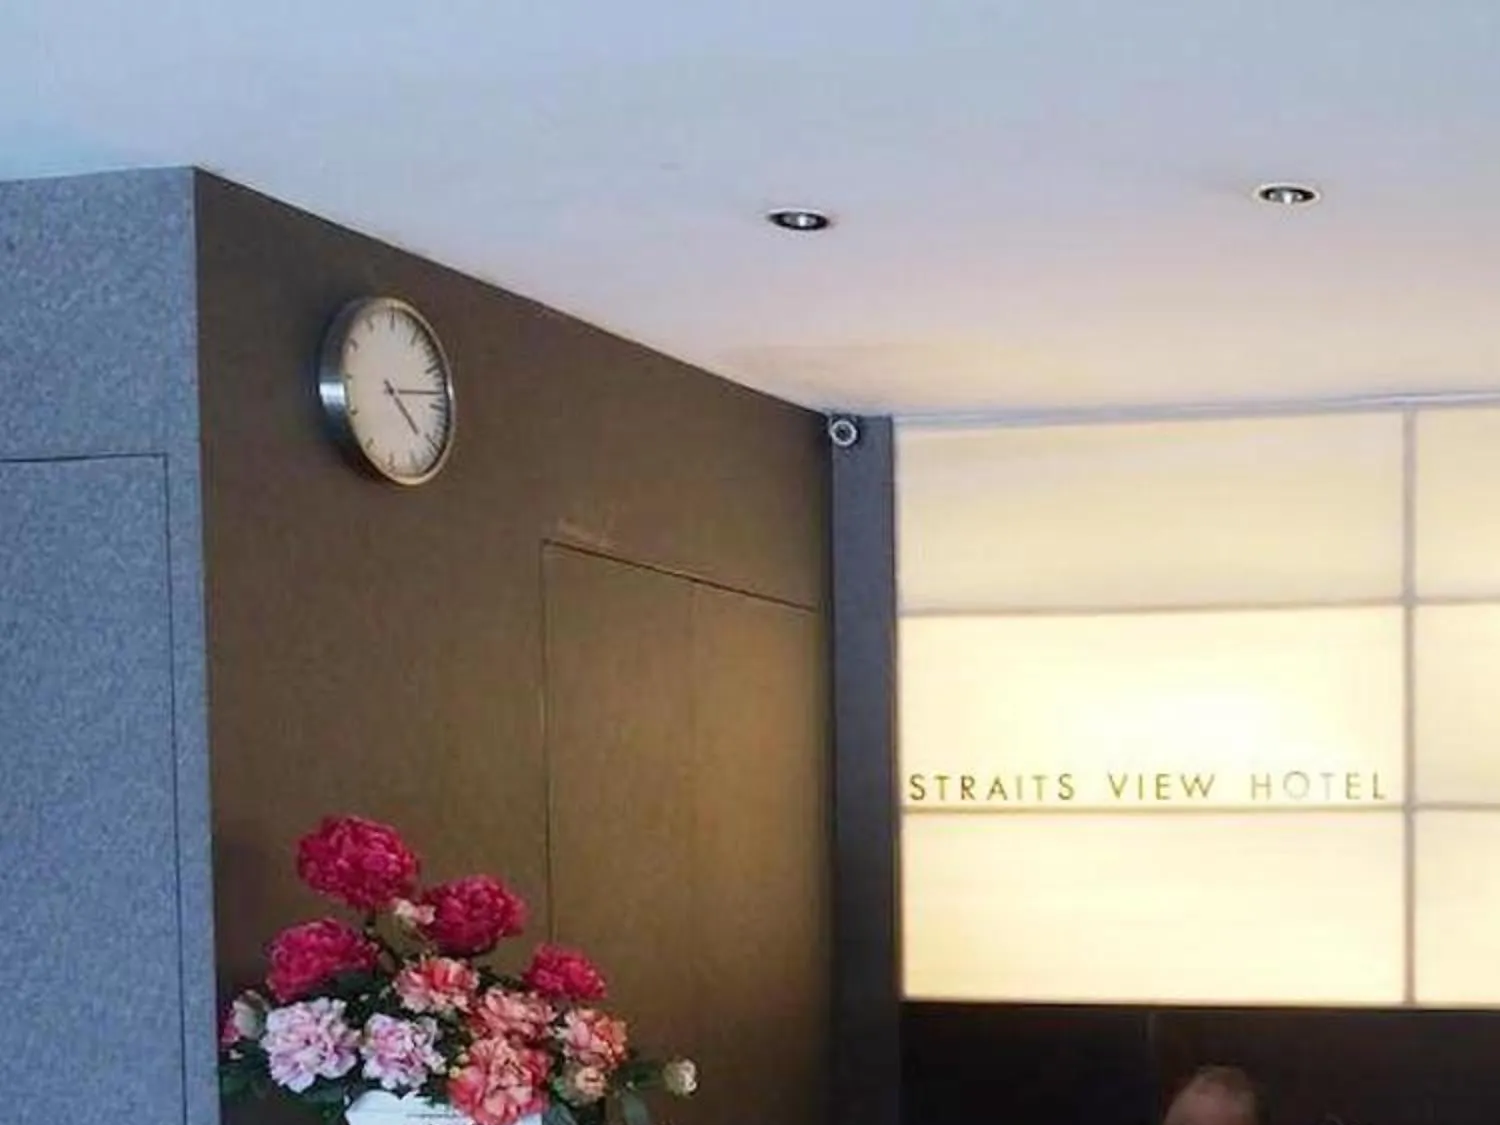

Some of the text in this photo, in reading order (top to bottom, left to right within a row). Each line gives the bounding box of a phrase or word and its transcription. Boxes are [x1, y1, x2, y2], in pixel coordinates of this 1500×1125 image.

[908, 770, 1386, 800] STRAITS VIEW HOTEL
